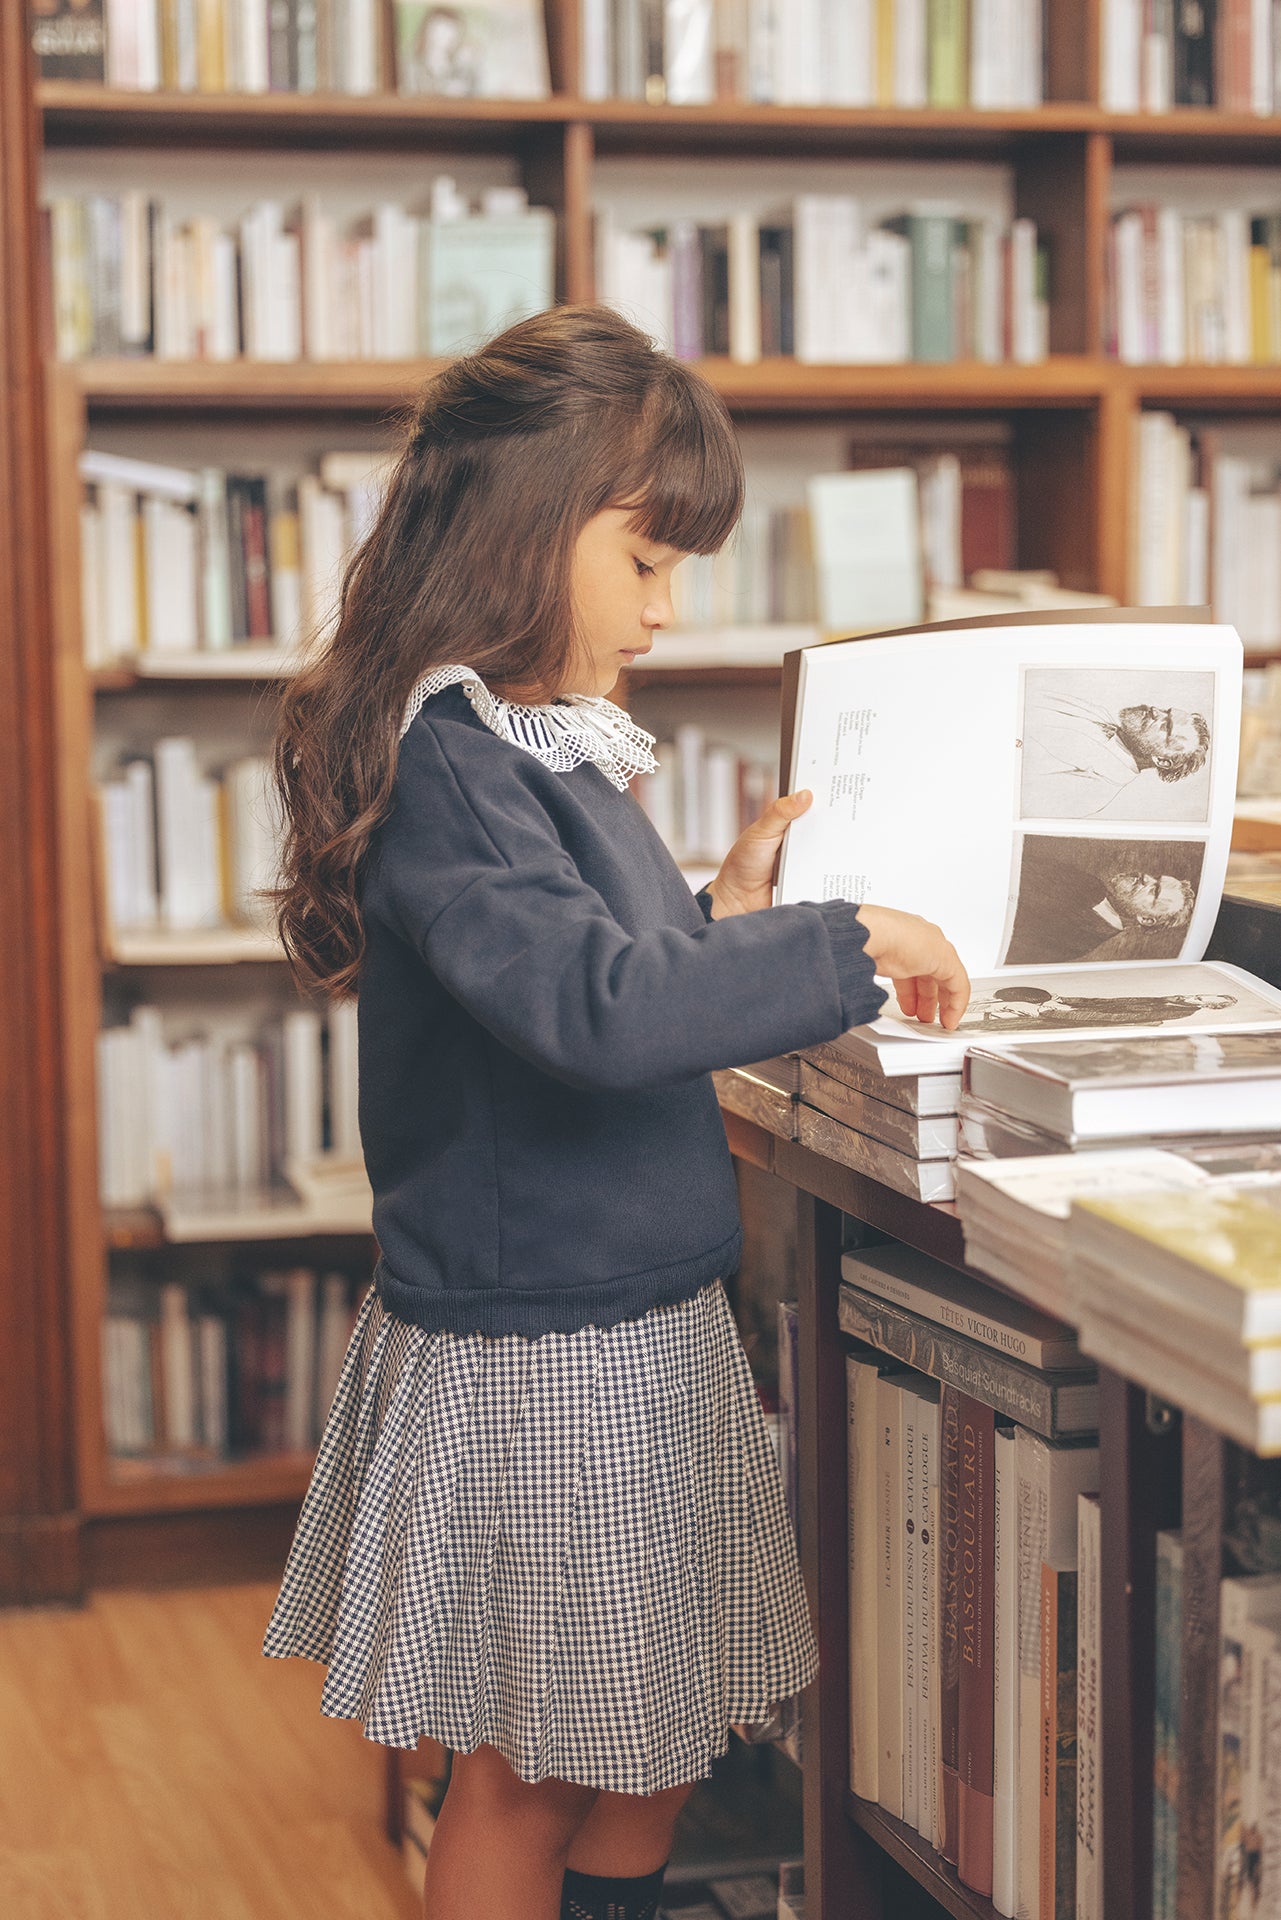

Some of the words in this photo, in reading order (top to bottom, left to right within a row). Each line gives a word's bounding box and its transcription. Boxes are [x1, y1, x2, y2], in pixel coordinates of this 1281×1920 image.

[940, 1305, 965, 1329] TÊTES
[967, 1317, 999, 1342] VICTOR
[1000, 1333, 1027, 1355] HUGO
[941, 1351, 982, 1387] Basquiat
[981, 1373, 1042, 1418] Soundtracks
[906, 1423, 914, 1514] CATALOGUE
[921, 1432, 929, 1524] CATALOGUE
[884, 1524, 892, 1572] CAHIER
[945, 1403, 958, 1642] BASCOULARD
[963, 1422, 976, 1664] BASCOULARD
[1023, 1480, 1032, 1581] VALENTINE
[906, 1539, 914, 1592] DESSIN
[921, 1549, 929, 1602] DESSIN
[906, 1594, 914, 1617] DU
[921, 1605, 929, 1629] DU
[906, 1621, 915, 1688] FESTIVAL
[921, 1634, 929, 1700] FESTIVAL
[1078, 1647, 1086, 1731] Sixties
[1086, 1657, 1096, 1743] Sixties
[1076, 1738, 1085, 1845] Forever
[1085, 1749, 1095, 1857] Forever
